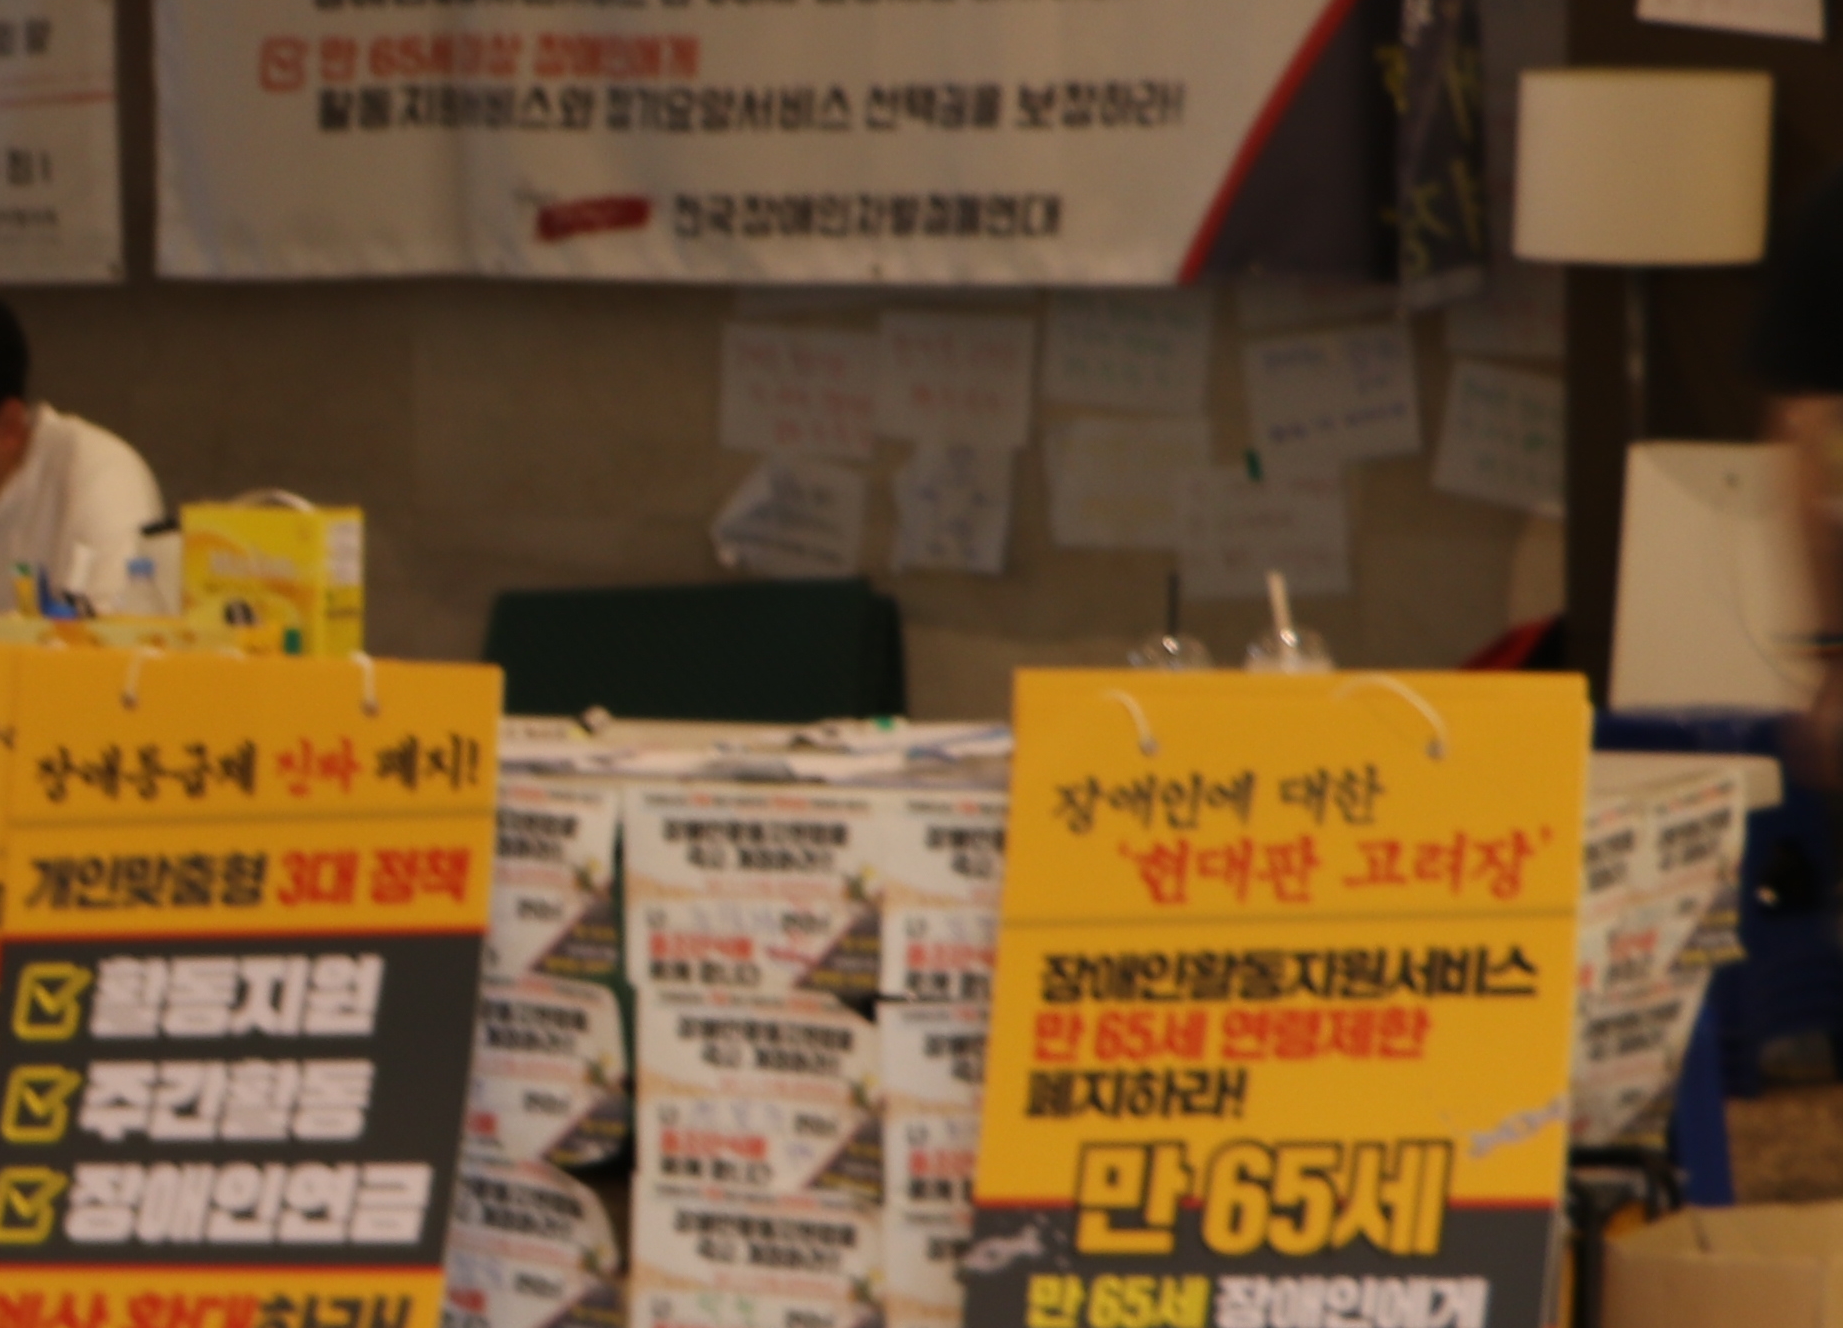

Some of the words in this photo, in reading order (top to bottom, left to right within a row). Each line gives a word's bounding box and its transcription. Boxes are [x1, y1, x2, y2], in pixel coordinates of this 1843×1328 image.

[1057, 771, 1255, 834] 장애인에
[1280, 764, 1386, 826] 대한
[277, 848, 359, 907] 3대
[88, 953, 385, 1037] 활동지원
[1042, 946, 1539, 1003] 장애인활동지원서비스
[1033, 1011, 1082, 1061] 만
[1093, 1009, 1208, 1061] 65세
[1220, 1006, 1431, 1059] 연령제한
[76, 1058, 377, 1142] 주간활동
[62, 1161, 434, 1246] 장애인연금
[1074, 1139, 1194, 1257] 만
[1200, 1139, 1455, 1257] 65세
